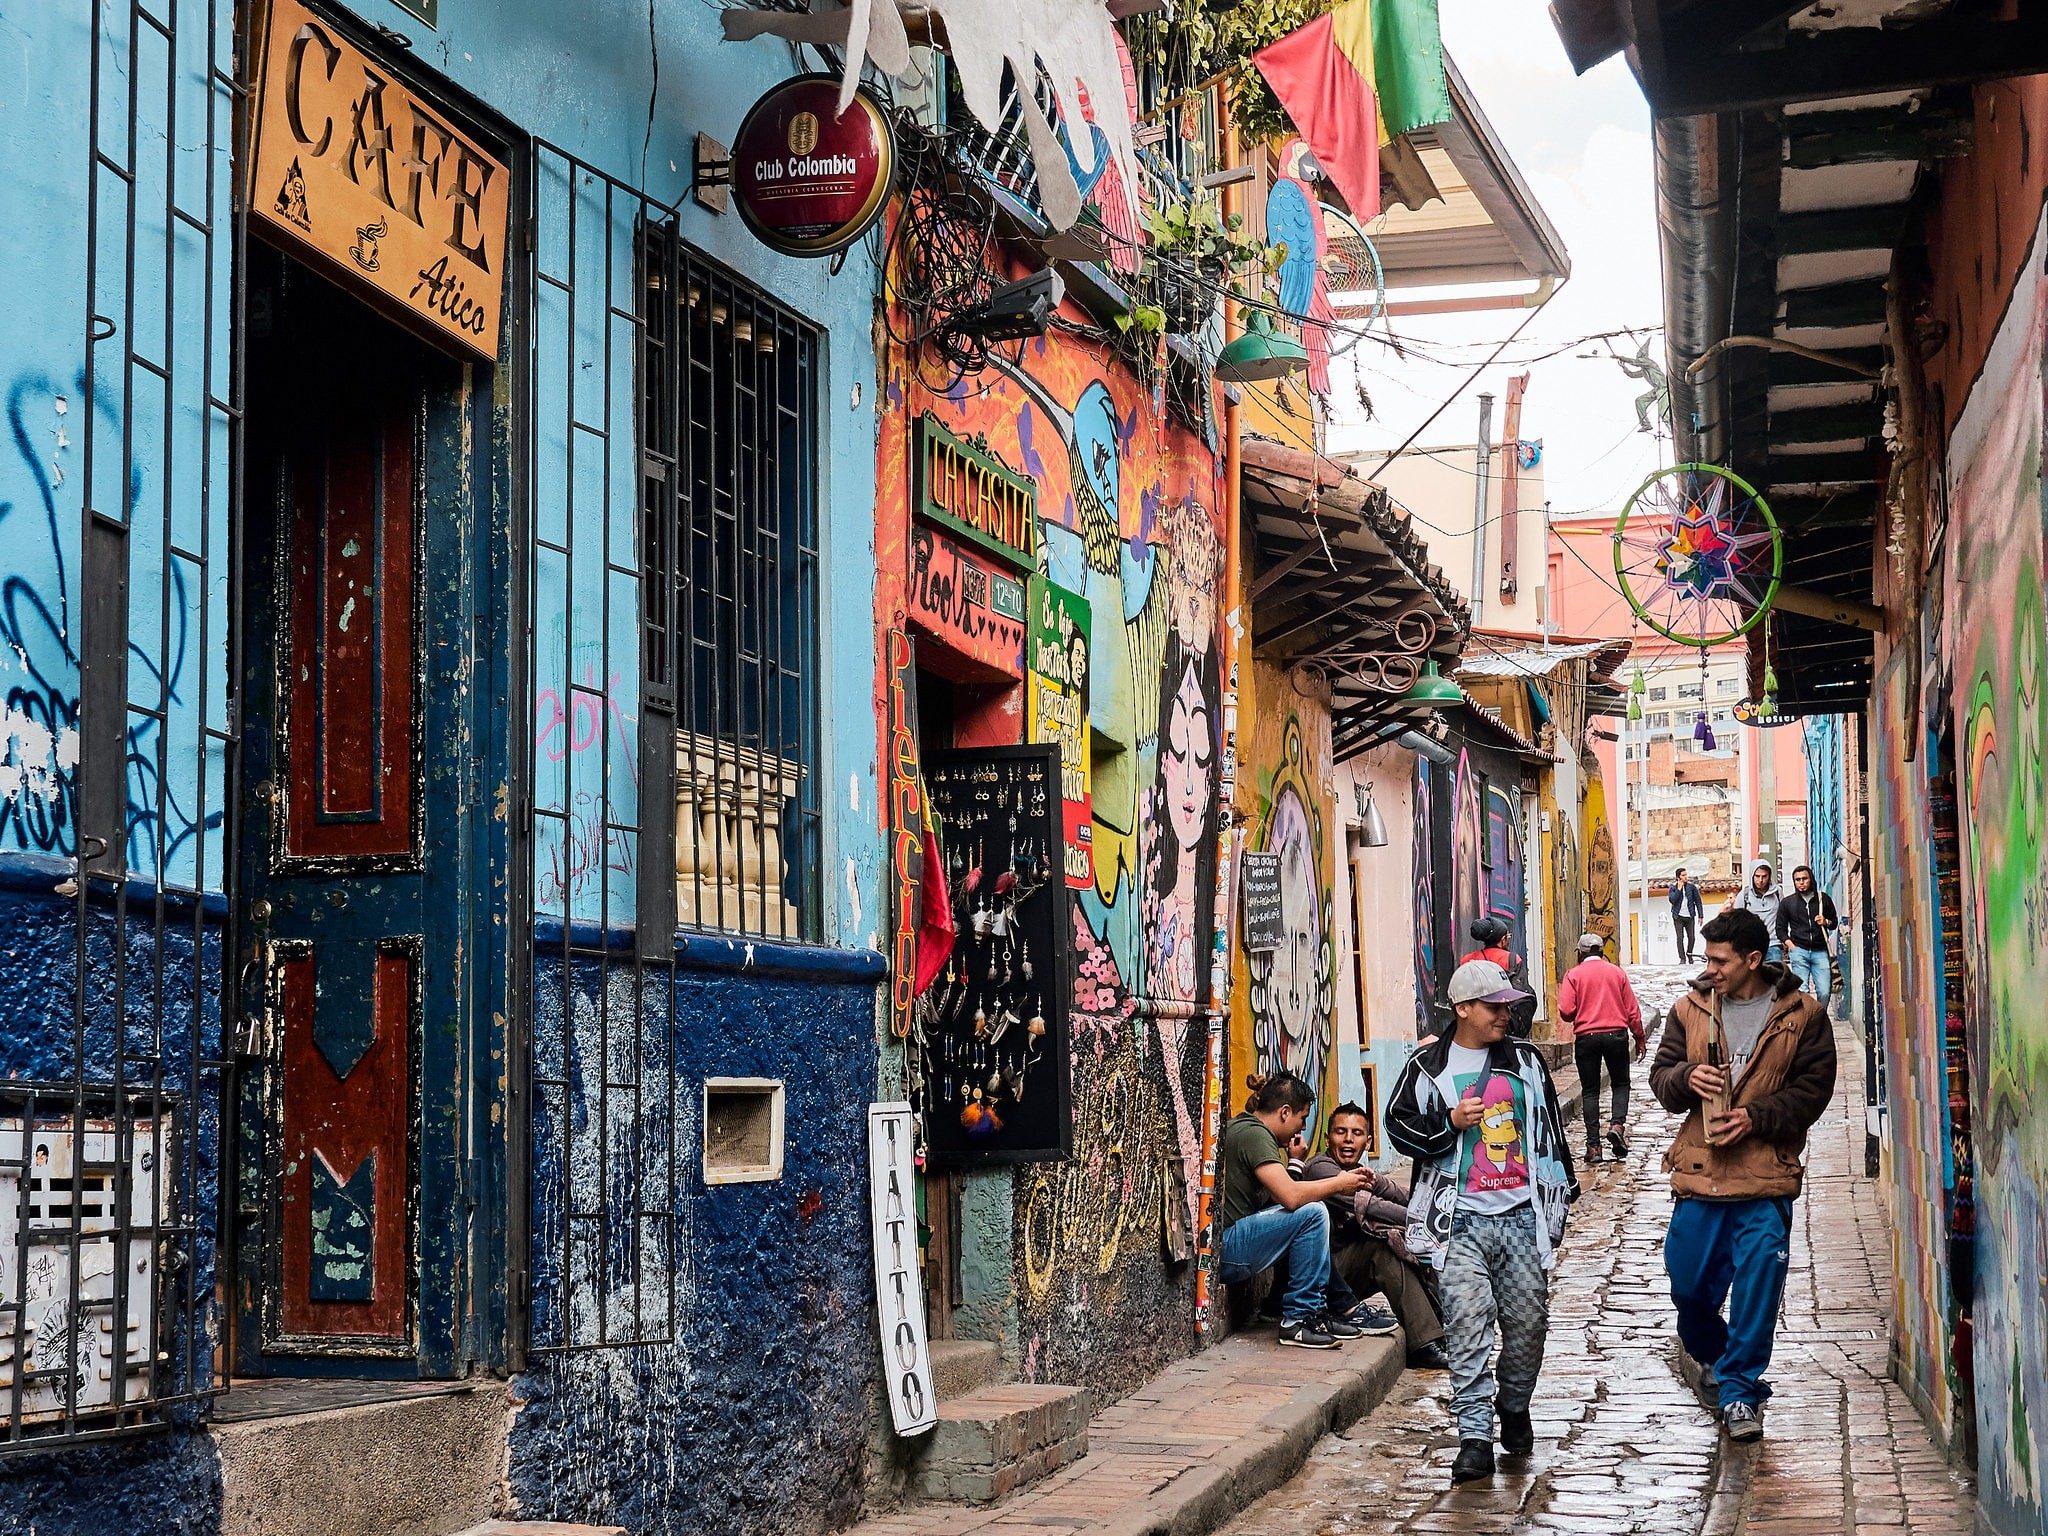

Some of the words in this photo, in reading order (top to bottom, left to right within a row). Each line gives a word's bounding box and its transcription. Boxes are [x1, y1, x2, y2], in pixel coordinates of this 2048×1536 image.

[285, 22, 496, 275] CAFE
[755, 159, 784, 181] Club
[788, 153, 856, 177] Colombia
[409, 255, 485, 336] Atico
[933, 435, 959, 518] LA
[965, 457, 1034, 557] CASITA
[1480, 1174, 1521, 1189] Supreme
[881, 1118, 923, 1423] TATTOO
